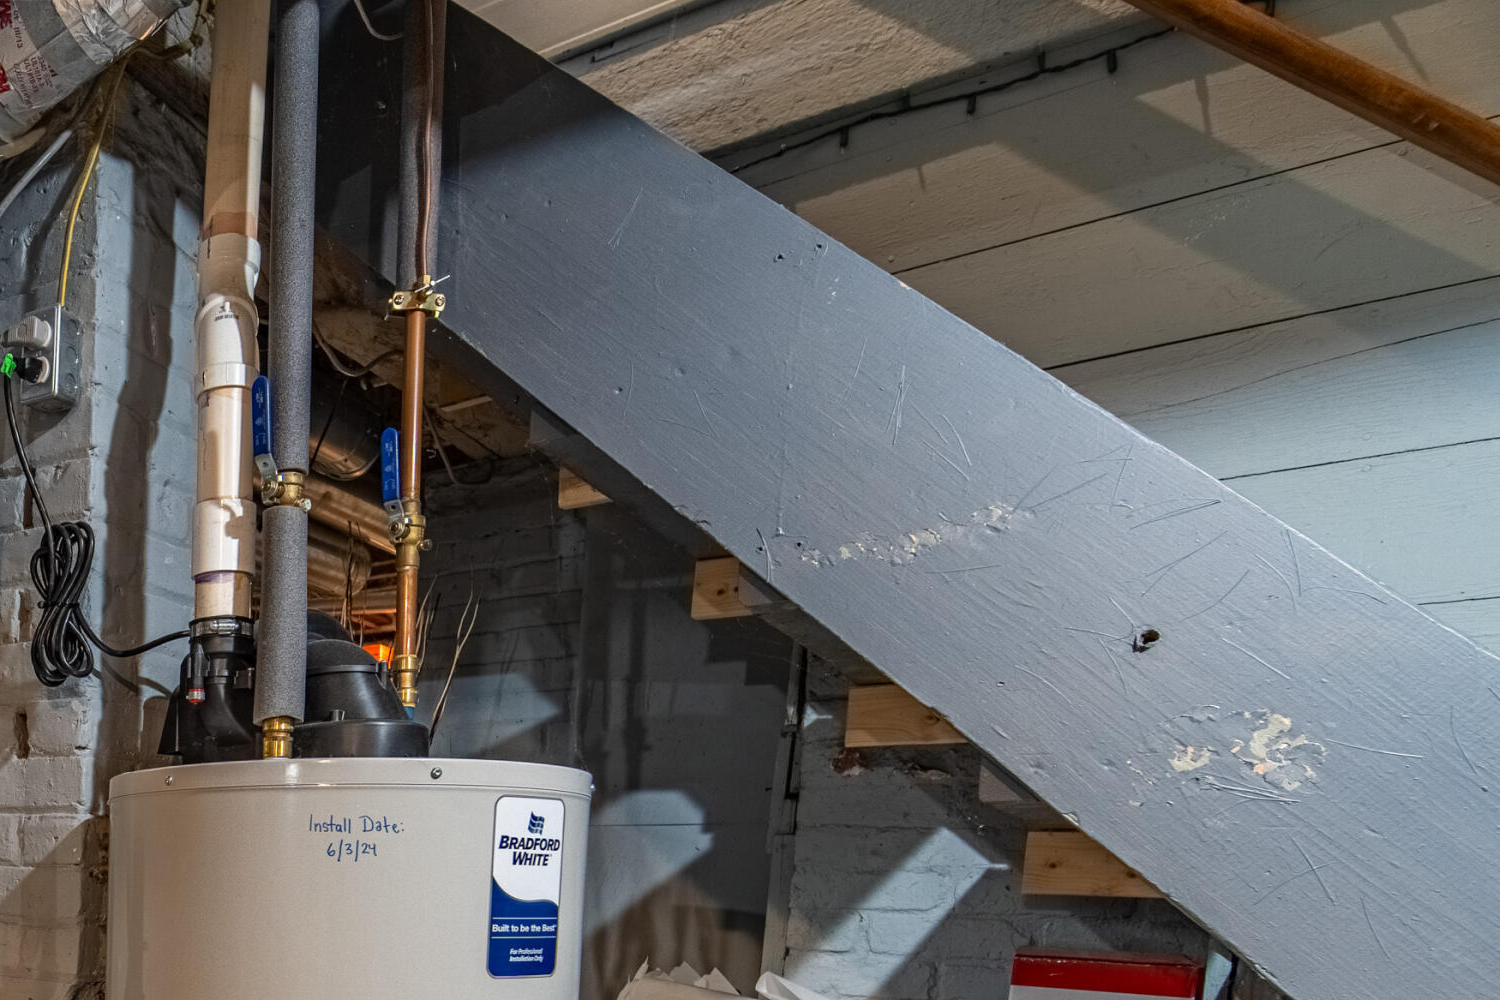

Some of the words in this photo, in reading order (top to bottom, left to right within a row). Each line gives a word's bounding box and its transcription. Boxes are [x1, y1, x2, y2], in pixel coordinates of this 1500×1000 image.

[309, 814, 351, 834] Install
[359, 816, 405, 833] Date:
[326, 840, 377, 862] 6/3/24
[499, 835, 560, 851] BRADFORD
[512, 851, 549, 866] WHITE
[492, 924, 509, 932] Built
[511, 924, 518, 932] to
[520, 924, 529, 932] be
[531, 924, 540, 932] the
